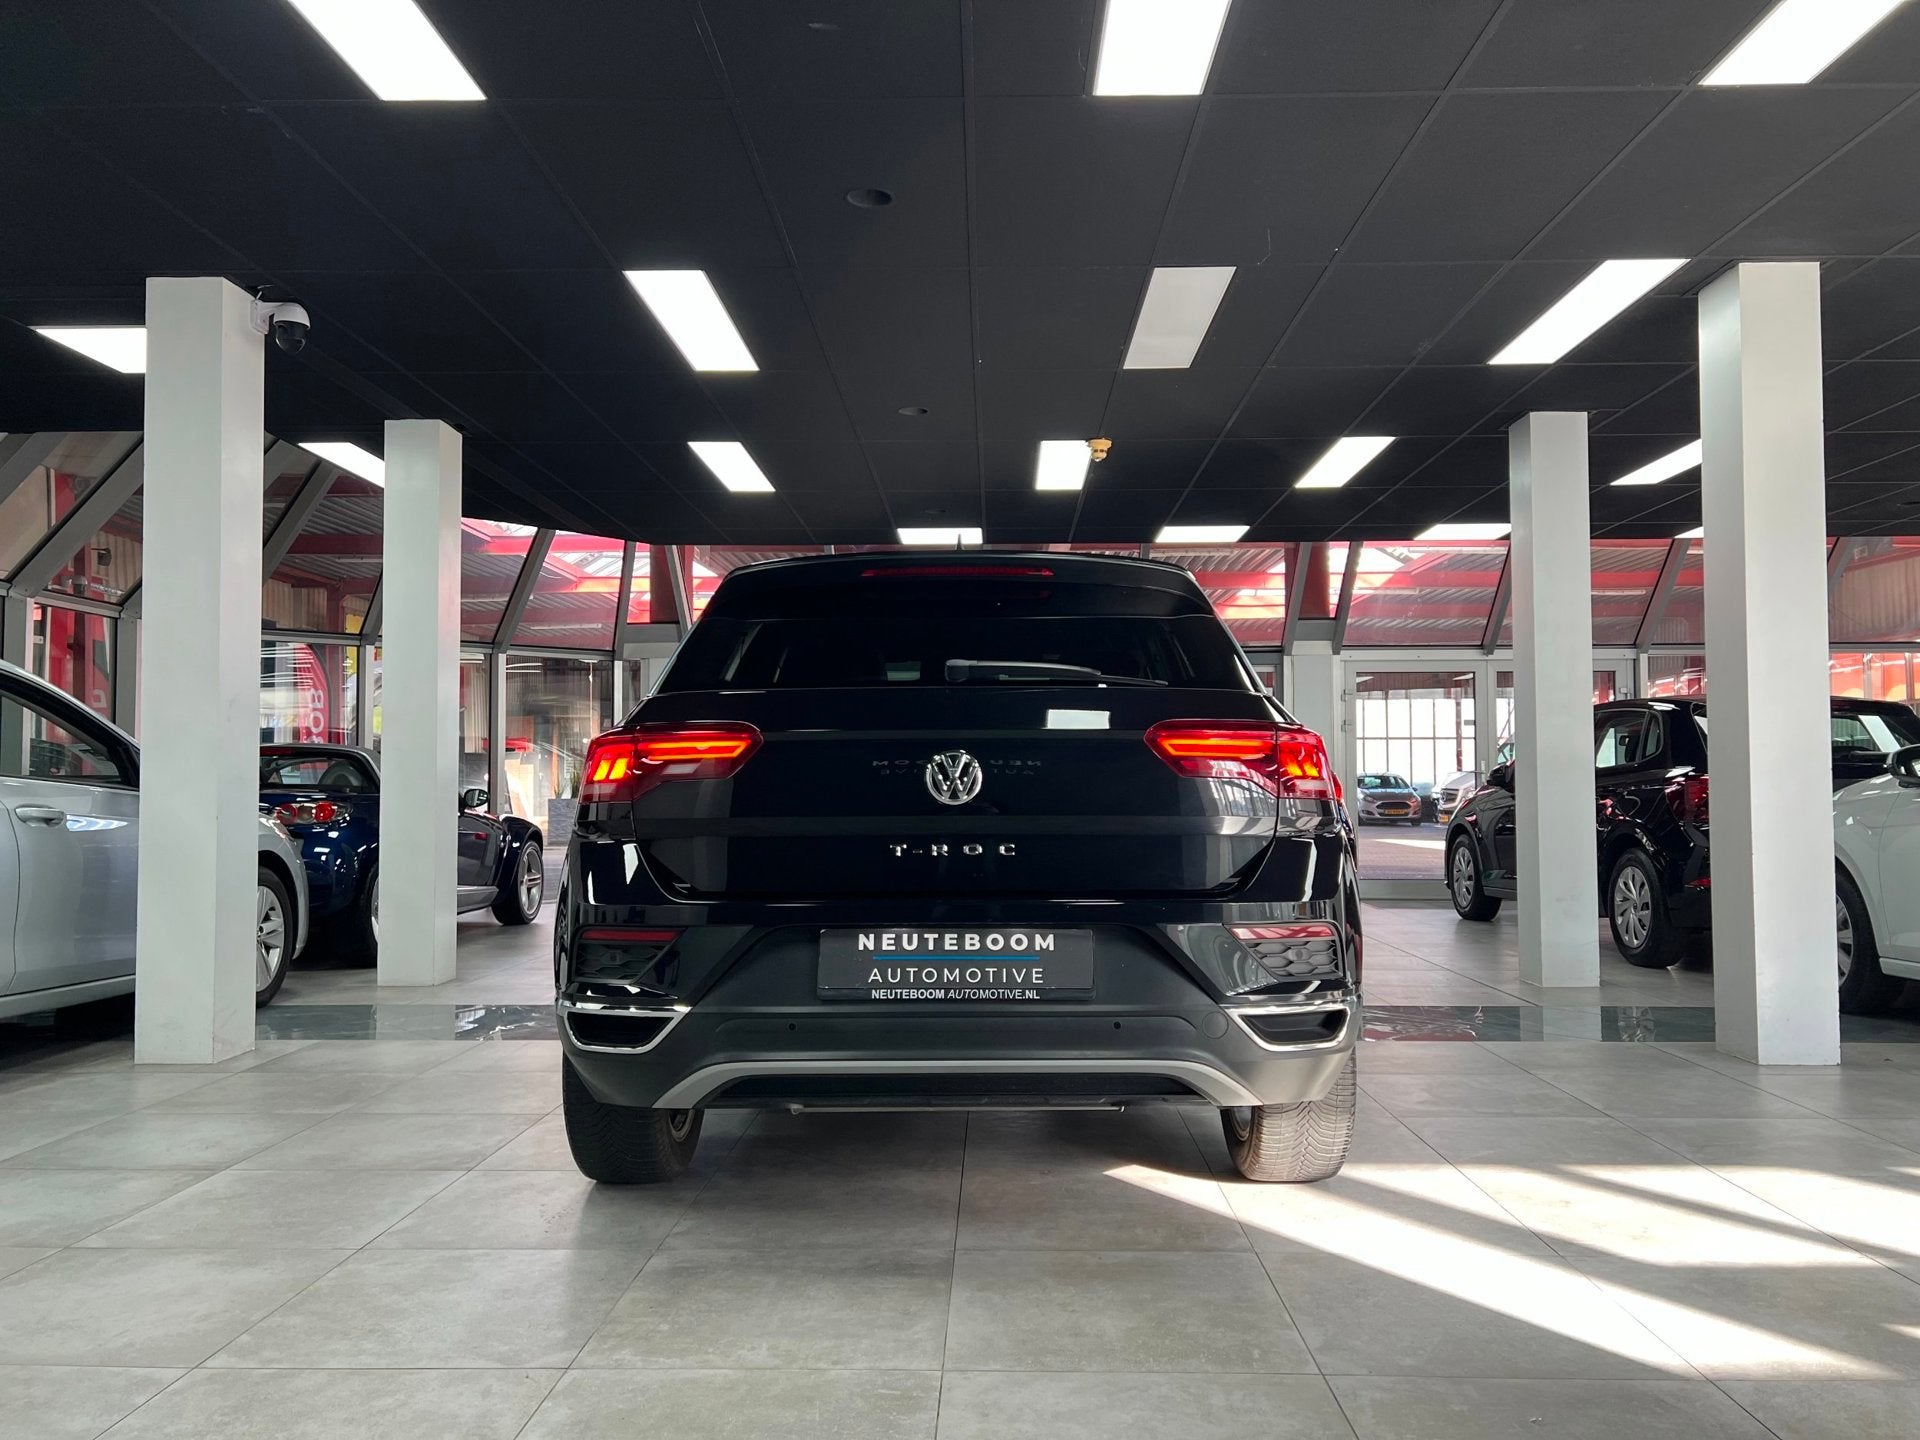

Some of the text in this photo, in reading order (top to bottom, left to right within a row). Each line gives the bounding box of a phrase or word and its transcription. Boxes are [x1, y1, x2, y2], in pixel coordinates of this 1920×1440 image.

[889, 843, 1017, 857] T-ROC
[858, 933, 1055, 951] NEUTEBOOM
[868, 967, 1044, 984] AUTOMOTIVE
[871, 989, 1041, 1000] NEUTEBOOM AUTOMOTIVE.NL
